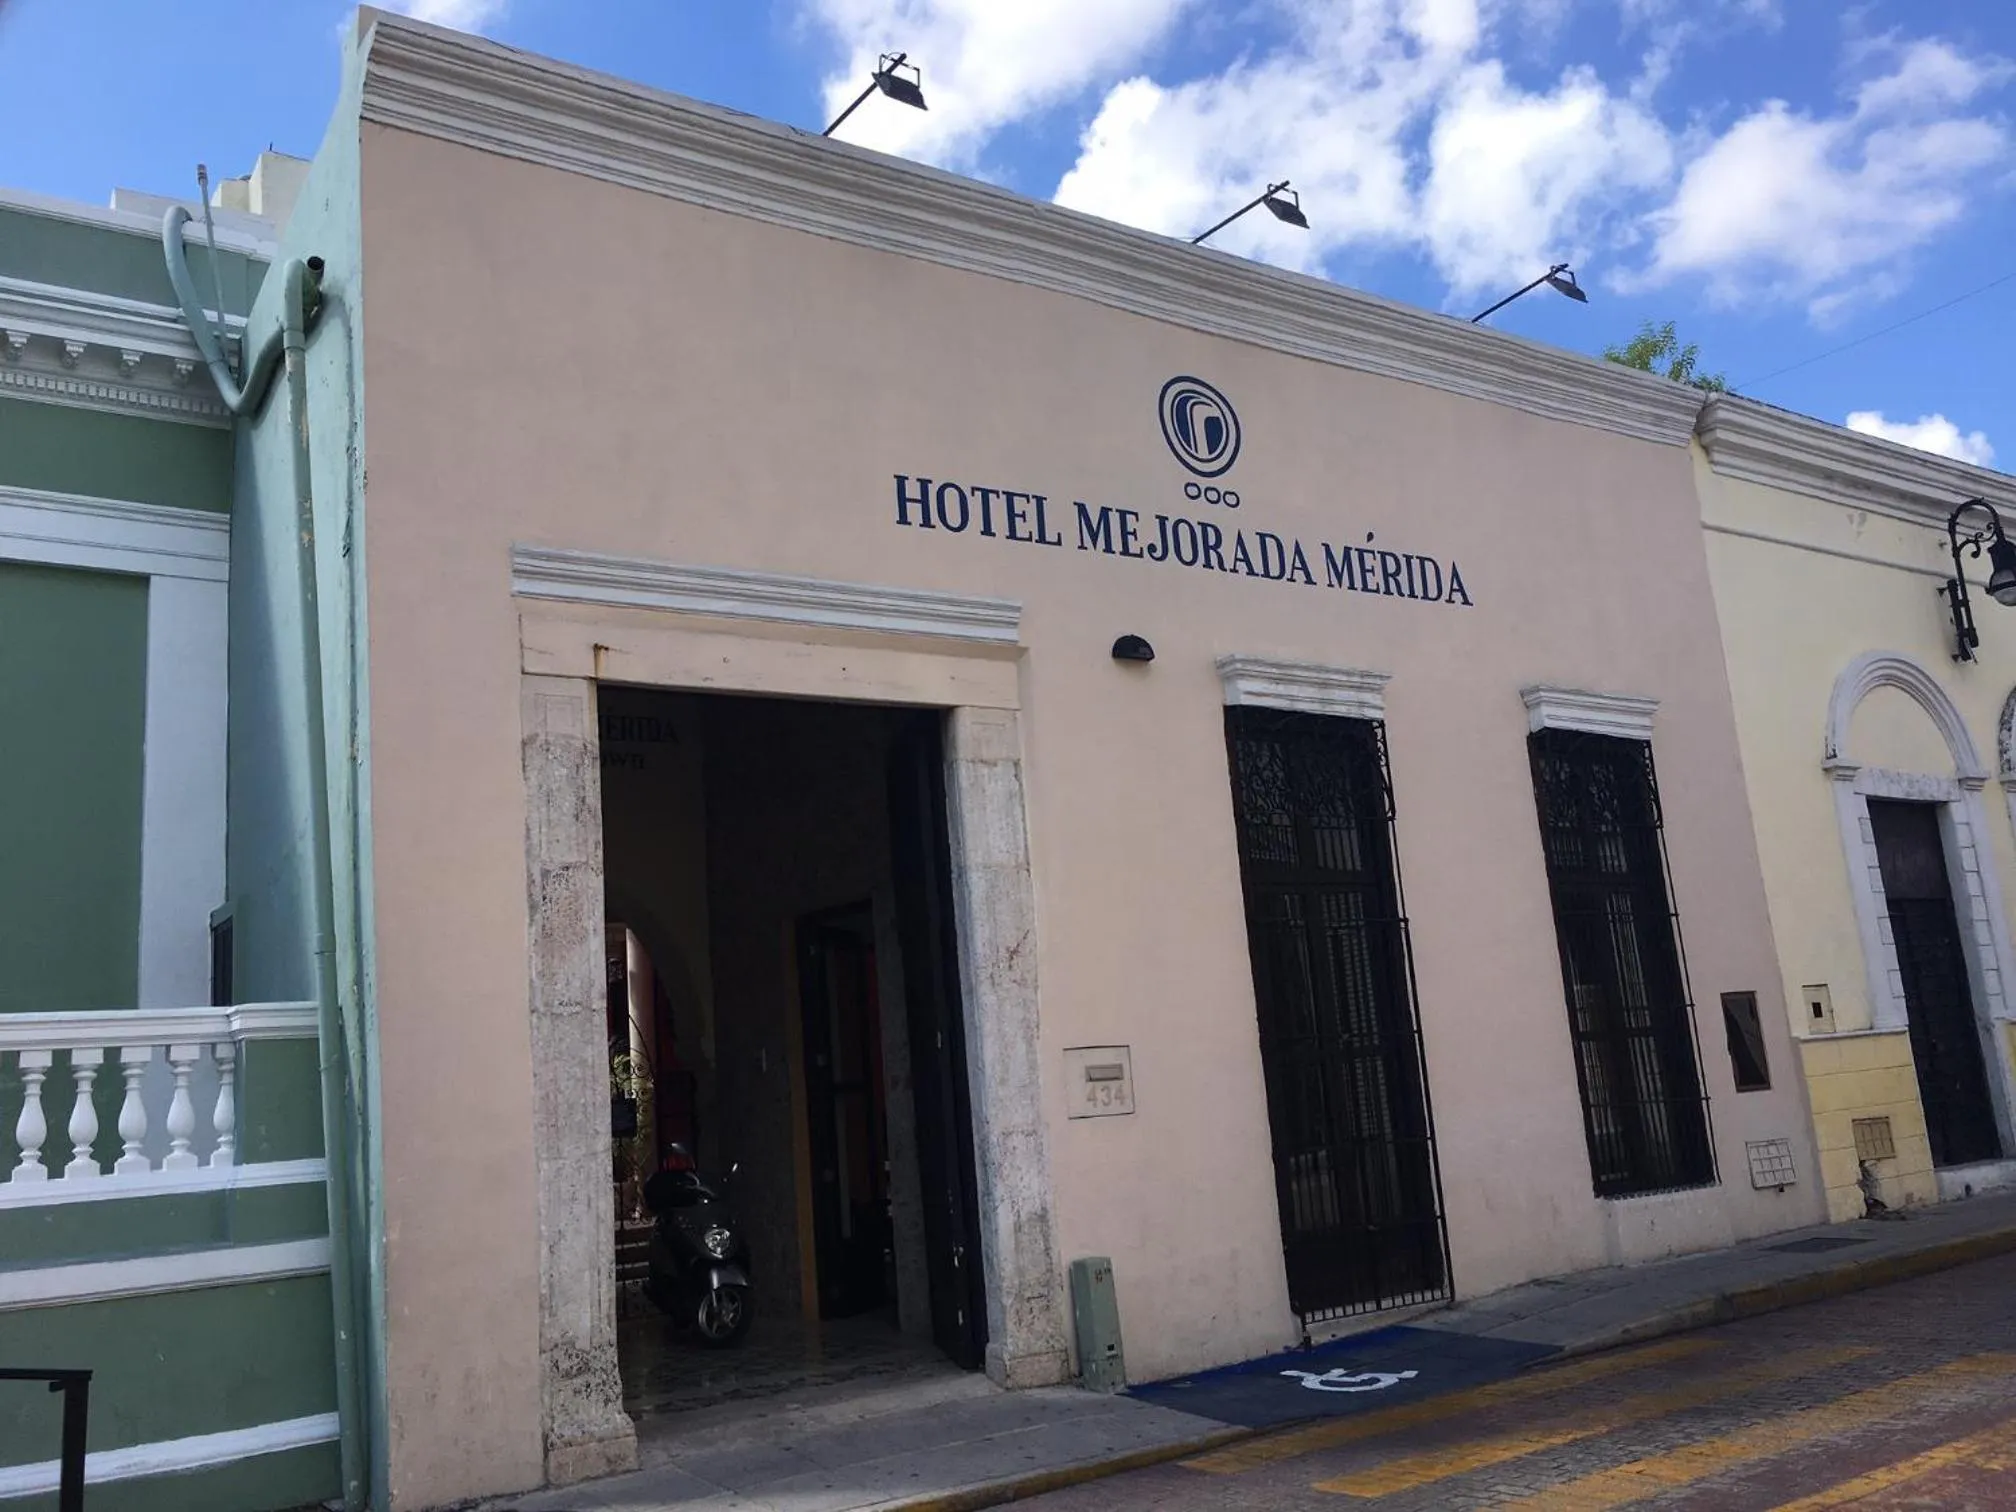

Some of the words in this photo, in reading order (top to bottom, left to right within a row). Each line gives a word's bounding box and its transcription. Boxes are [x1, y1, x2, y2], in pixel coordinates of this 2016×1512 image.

[893, 474, 1063, 547] HOTEL
[1073, 501, 1317, 586] MEJORADA
[1321, 531, 1474, 606] MÉRIDA
